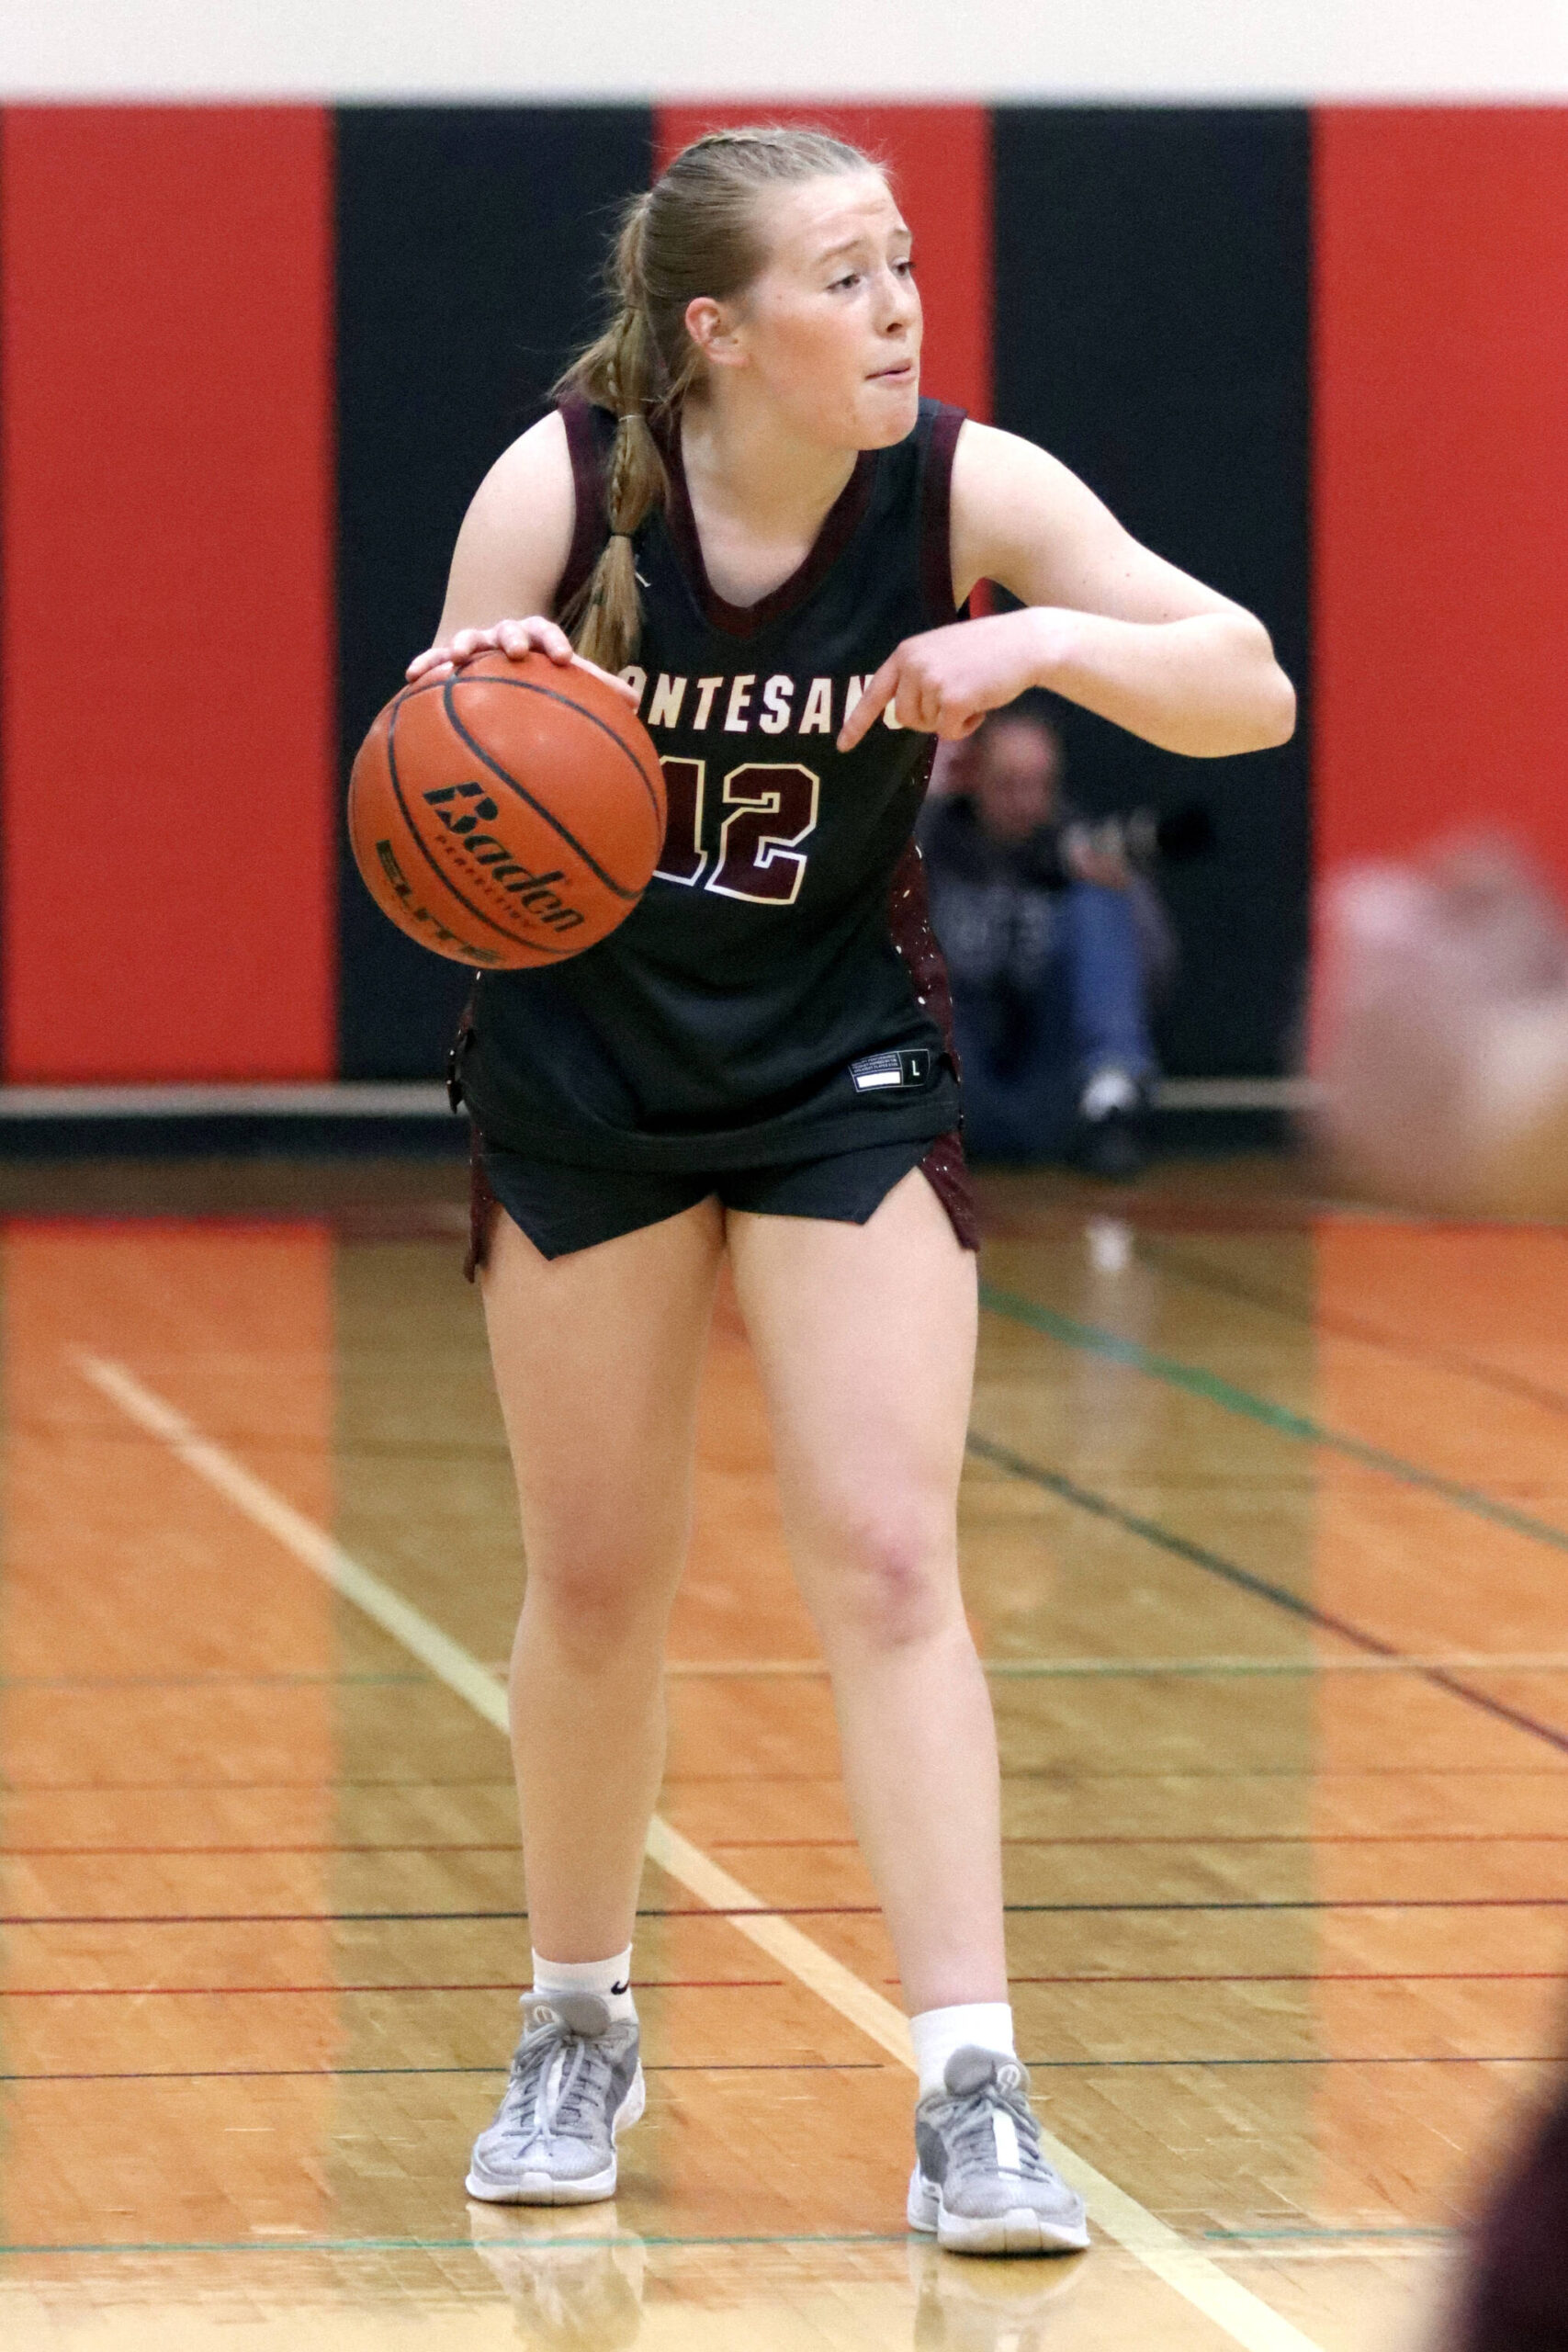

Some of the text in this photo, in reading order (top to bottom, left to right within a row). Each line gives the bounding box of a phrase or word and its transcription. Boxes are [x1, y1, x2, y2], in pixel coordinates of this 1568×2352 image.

[423, 781, 586, 933] Baden
[652, 754, 820, 905] 12
[911, 1059, 920, 1076] L
